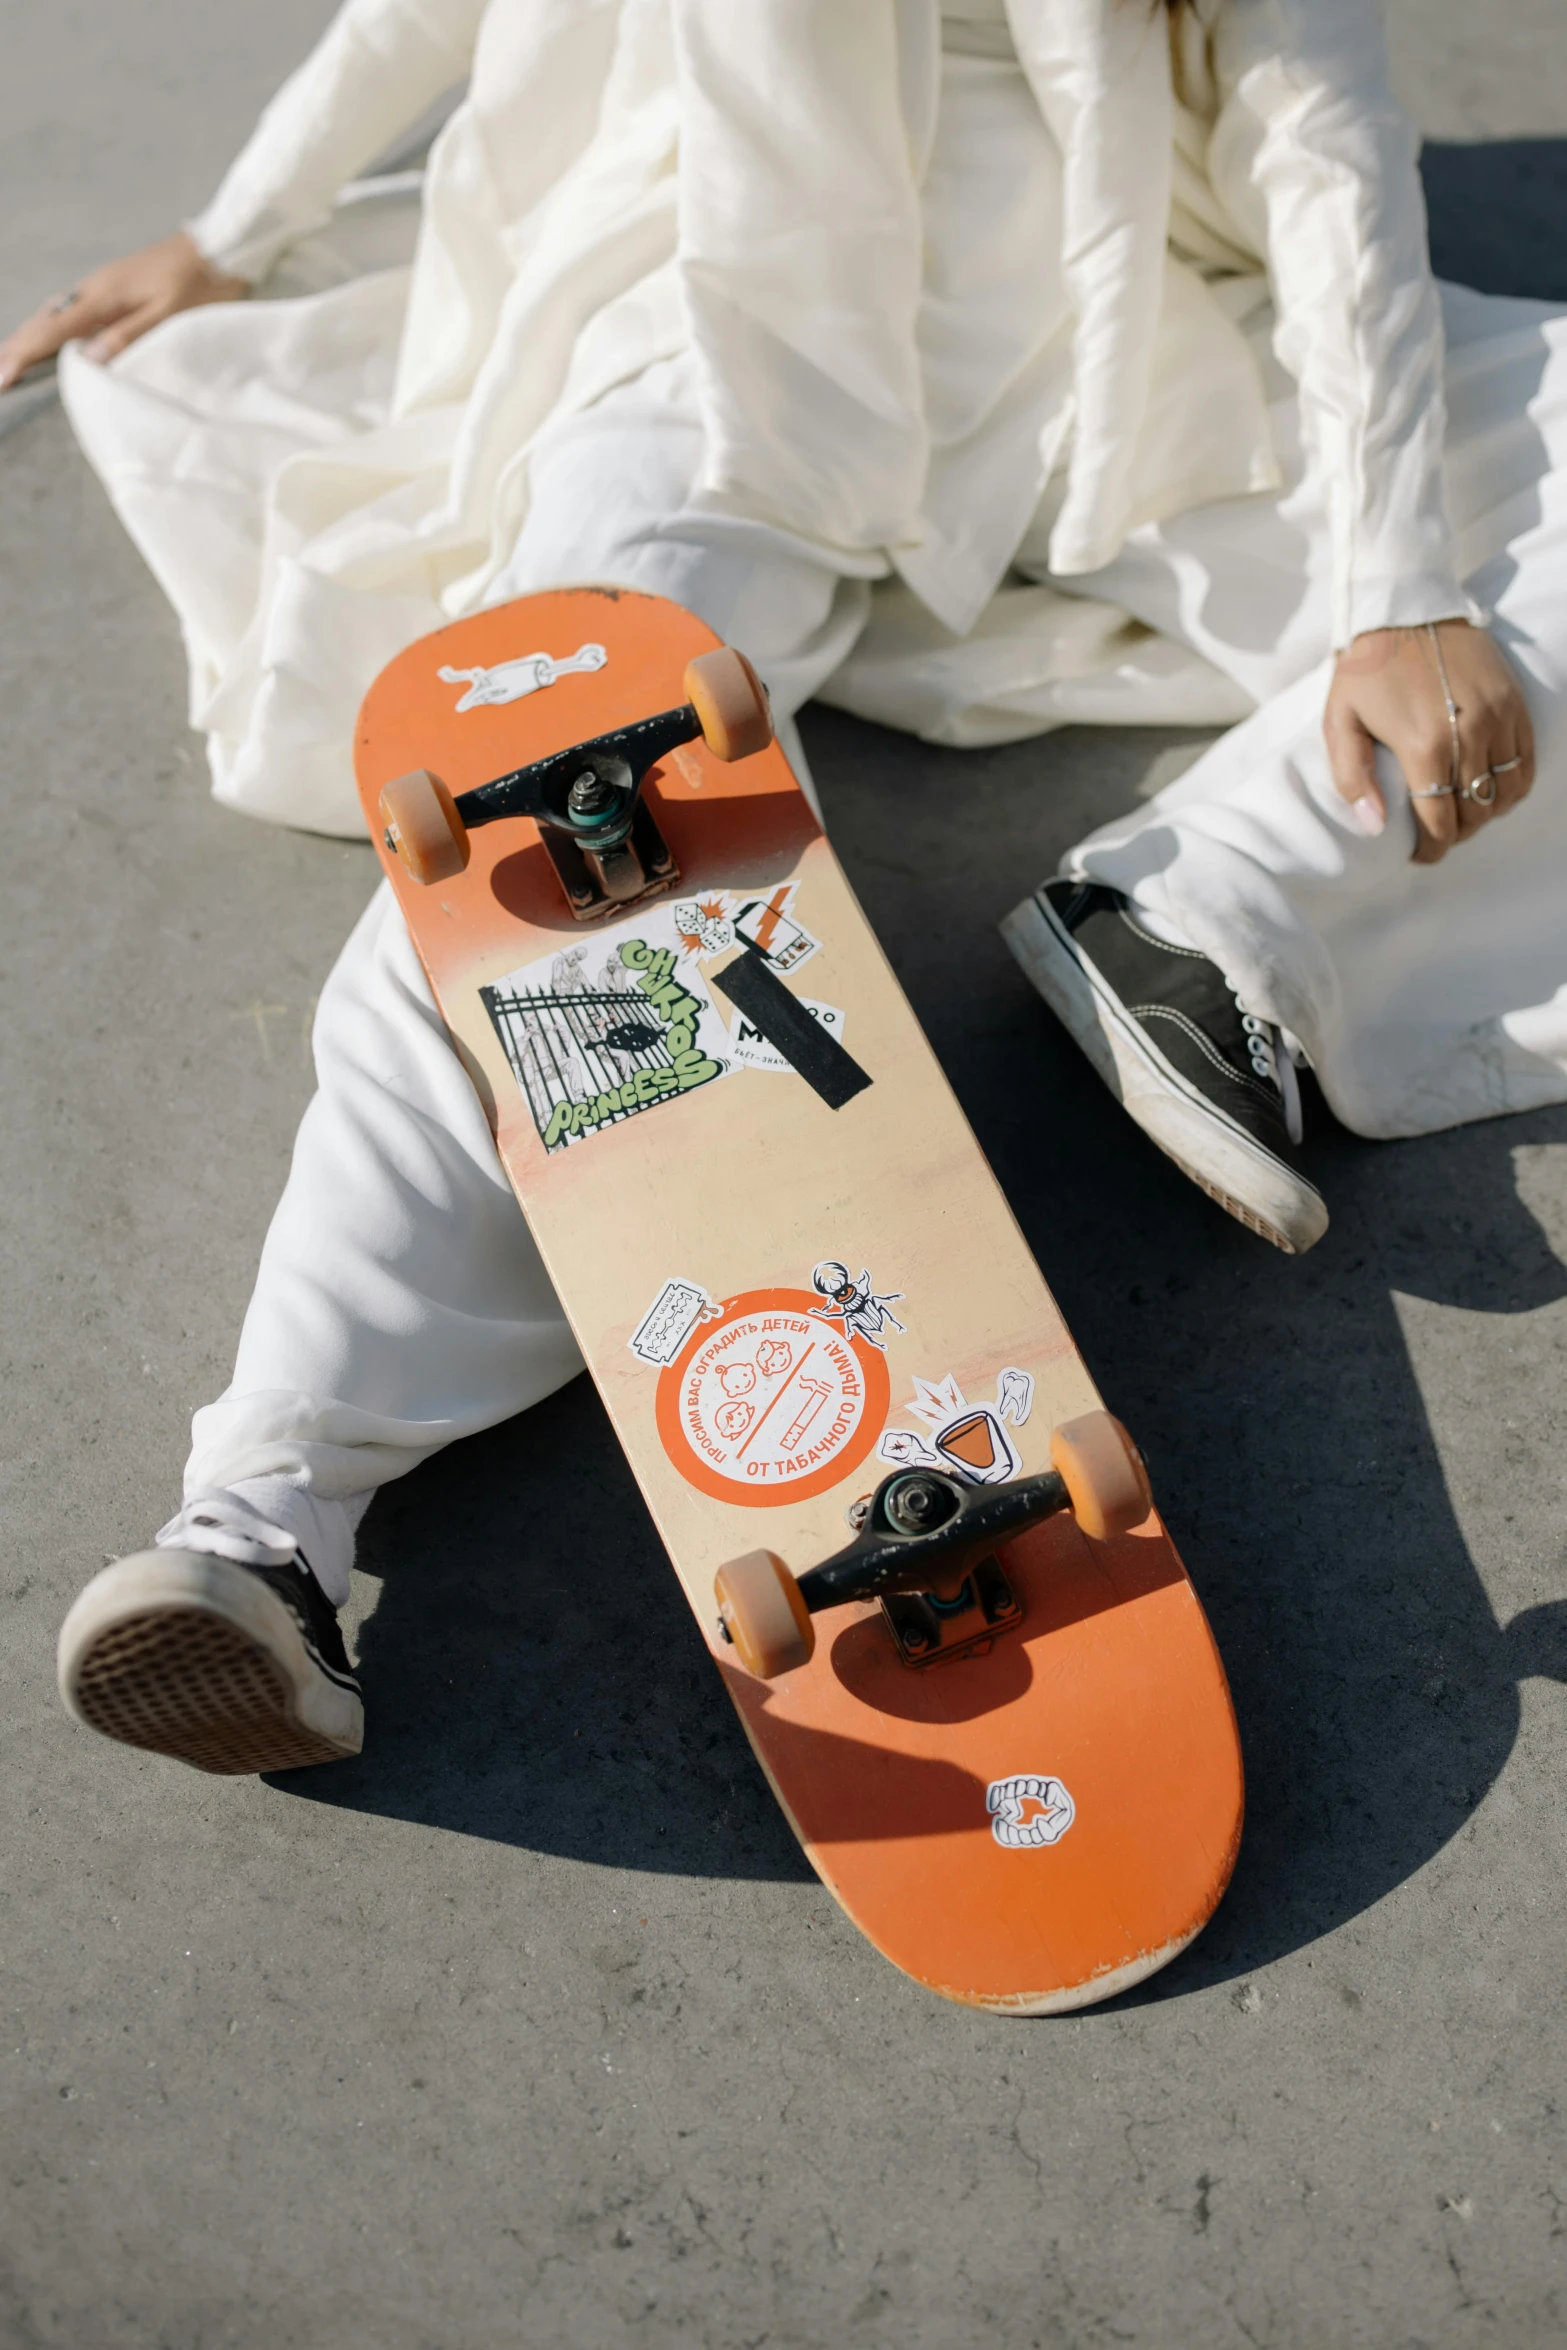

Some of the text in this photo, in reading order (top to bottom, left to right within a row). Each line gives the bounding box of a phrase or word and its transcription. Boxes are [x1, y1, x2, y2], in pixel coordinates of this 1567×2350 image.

[687, 1318, 812, 1465] ПРОСИМ ВАС ОГРАДИТЬ ДЕТЕЙ
[746, 1339, 861, 1477] ОТ ТАБАЧНОГО ДЫМА!
